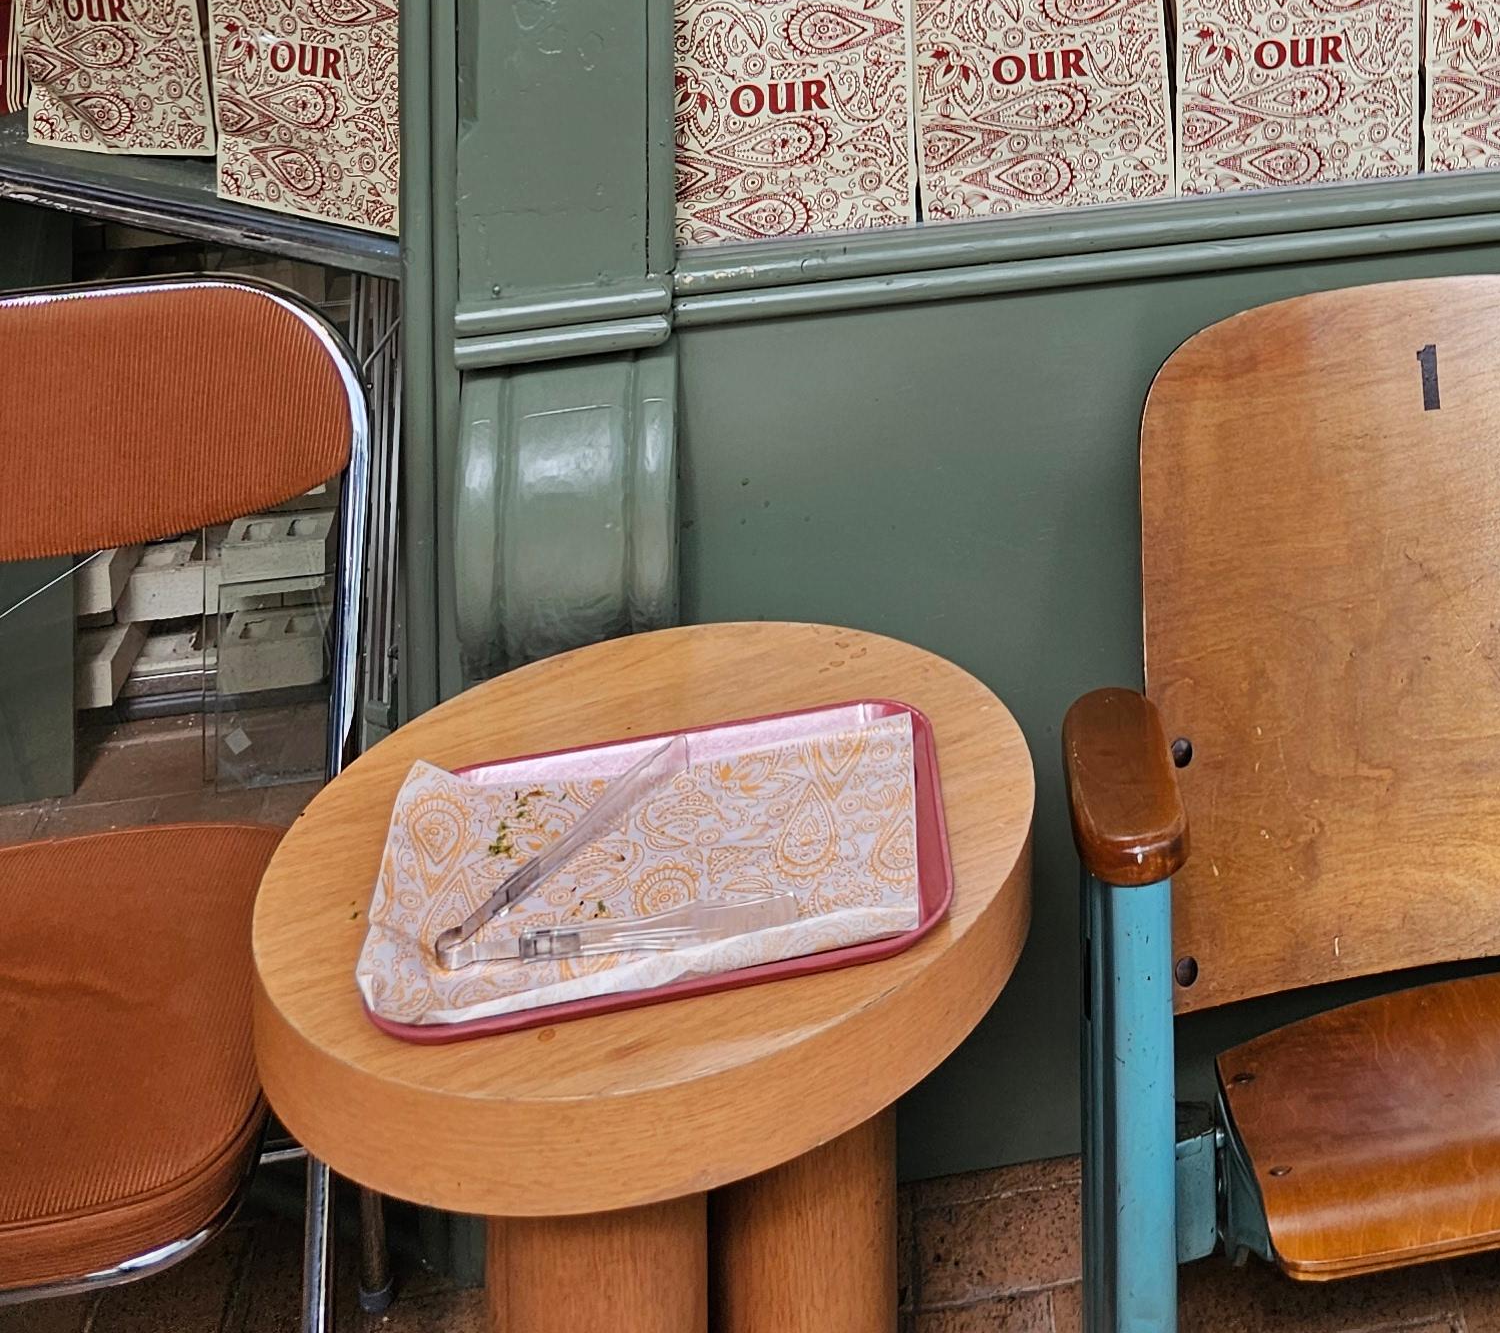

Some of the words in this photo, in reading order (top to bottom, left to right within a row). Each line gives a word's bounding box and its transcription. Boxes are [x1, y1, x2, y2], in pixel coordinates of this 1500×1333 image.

[269, 39, 342, 82] OUR
[992, 48, 1089, 86] OUR
[1253, 35, 1343, 70] OUR
[729, 79, 829, 118] OUR
[1416, 344, 1441, 410] 1
